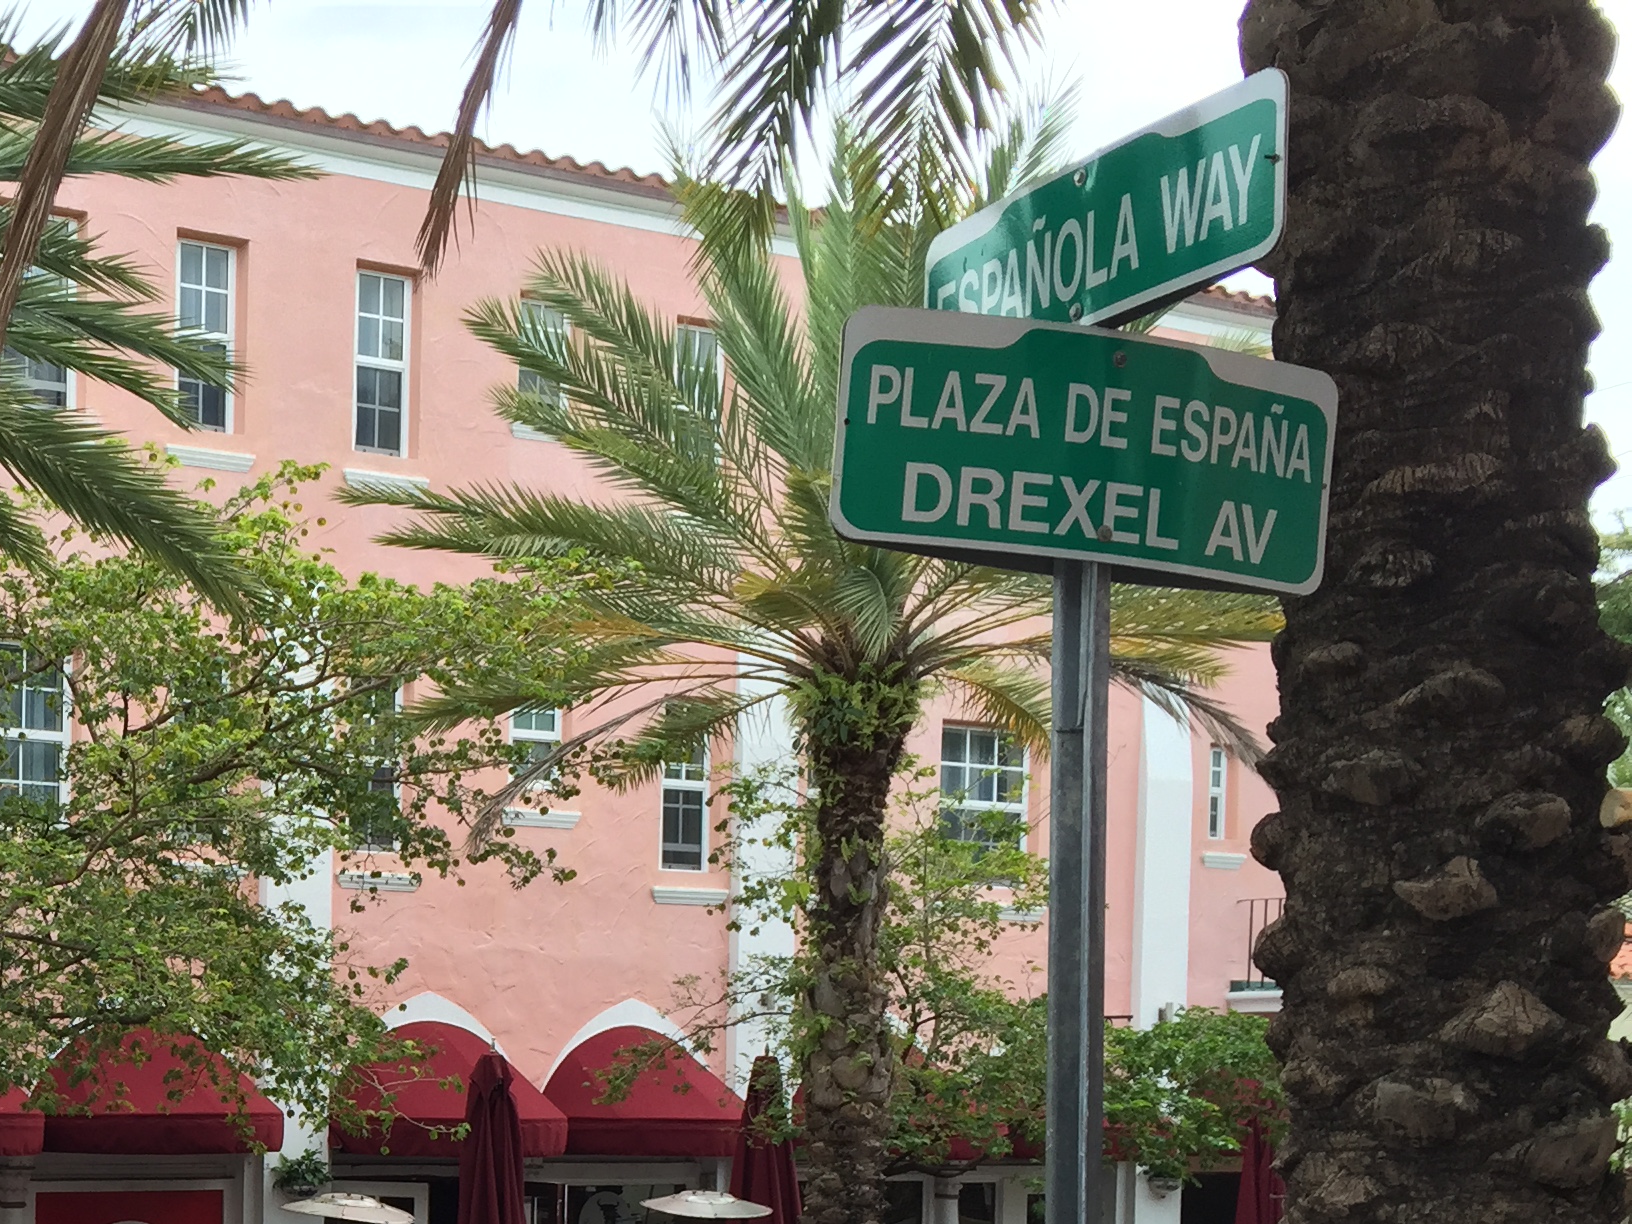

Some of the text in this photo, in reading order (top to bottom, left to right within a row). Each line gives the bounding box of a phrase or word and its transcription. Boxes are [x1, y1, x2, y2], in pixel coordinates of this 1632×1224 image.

[1160, 134, 1263, 253] WAY
[866, 363, 1312, 483] PLAZA DE ESPAÑA
[901, 461, 1277, 564] DREXEL AV
